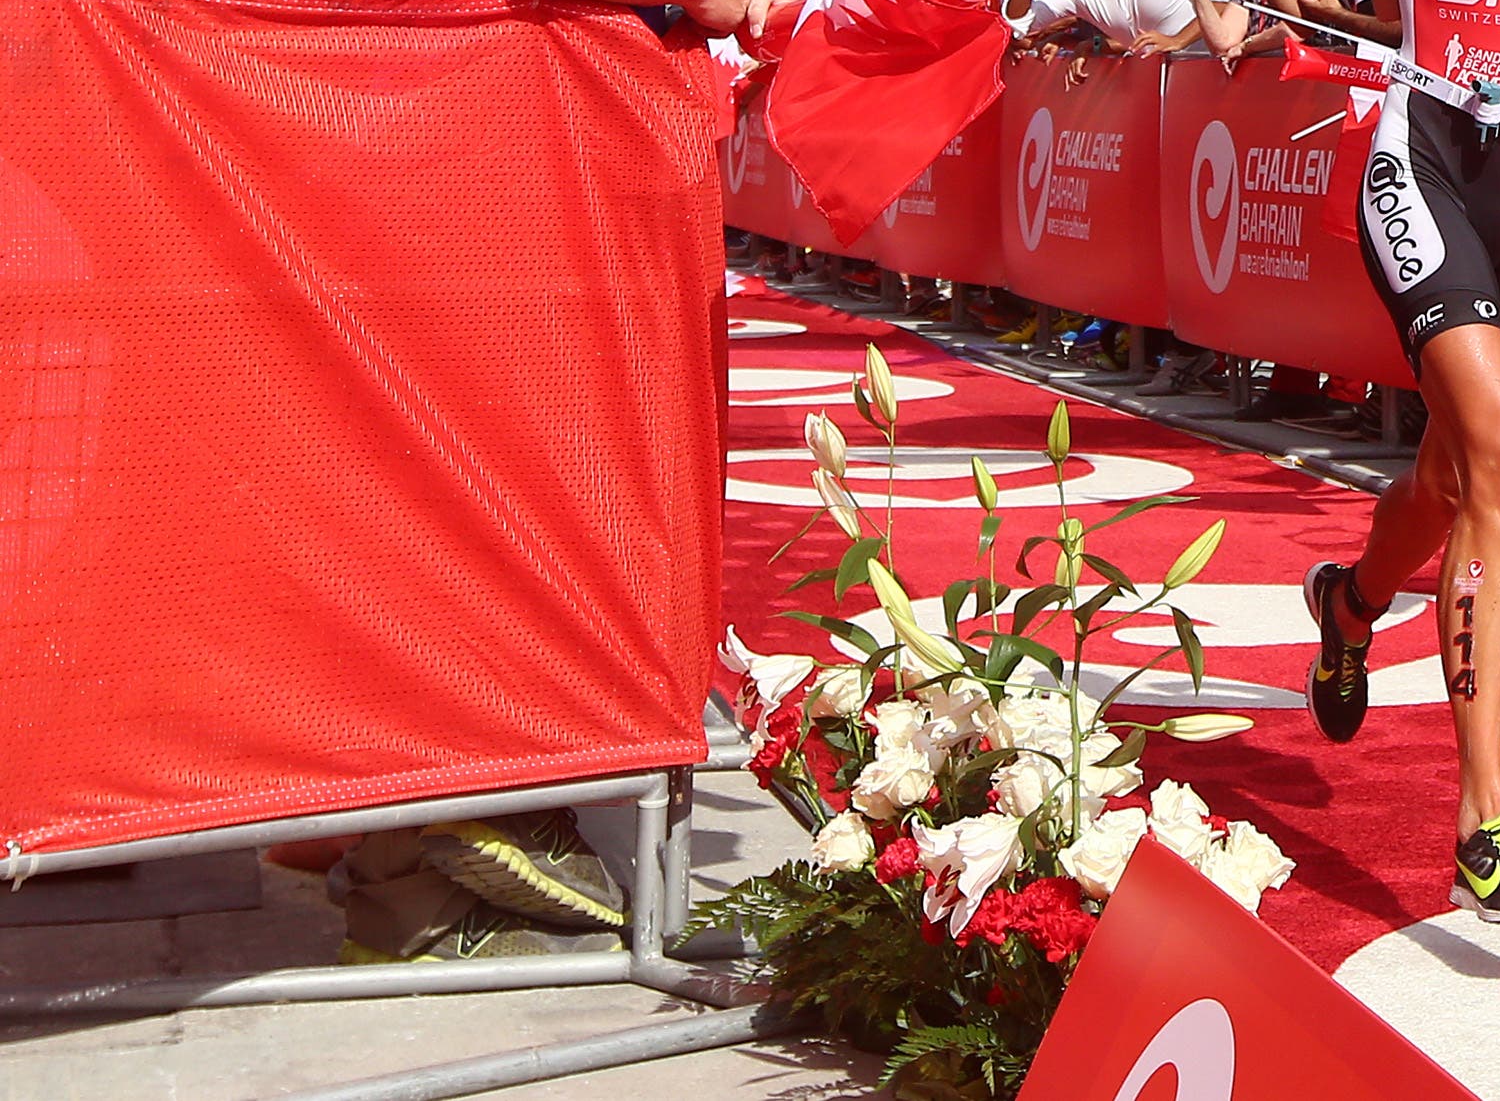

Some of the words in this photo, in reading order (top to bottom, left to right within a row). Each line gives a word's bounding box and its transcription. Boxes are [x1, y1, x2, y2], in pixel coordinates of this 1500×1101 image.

[1055, 130, 1124, 173] CHALLENGE
[1244, 148, 1336, 196] CHALLEN
[1240, 202, 1303, 247] BAHRAIN
[1451, 596, 1477, 702] 114
